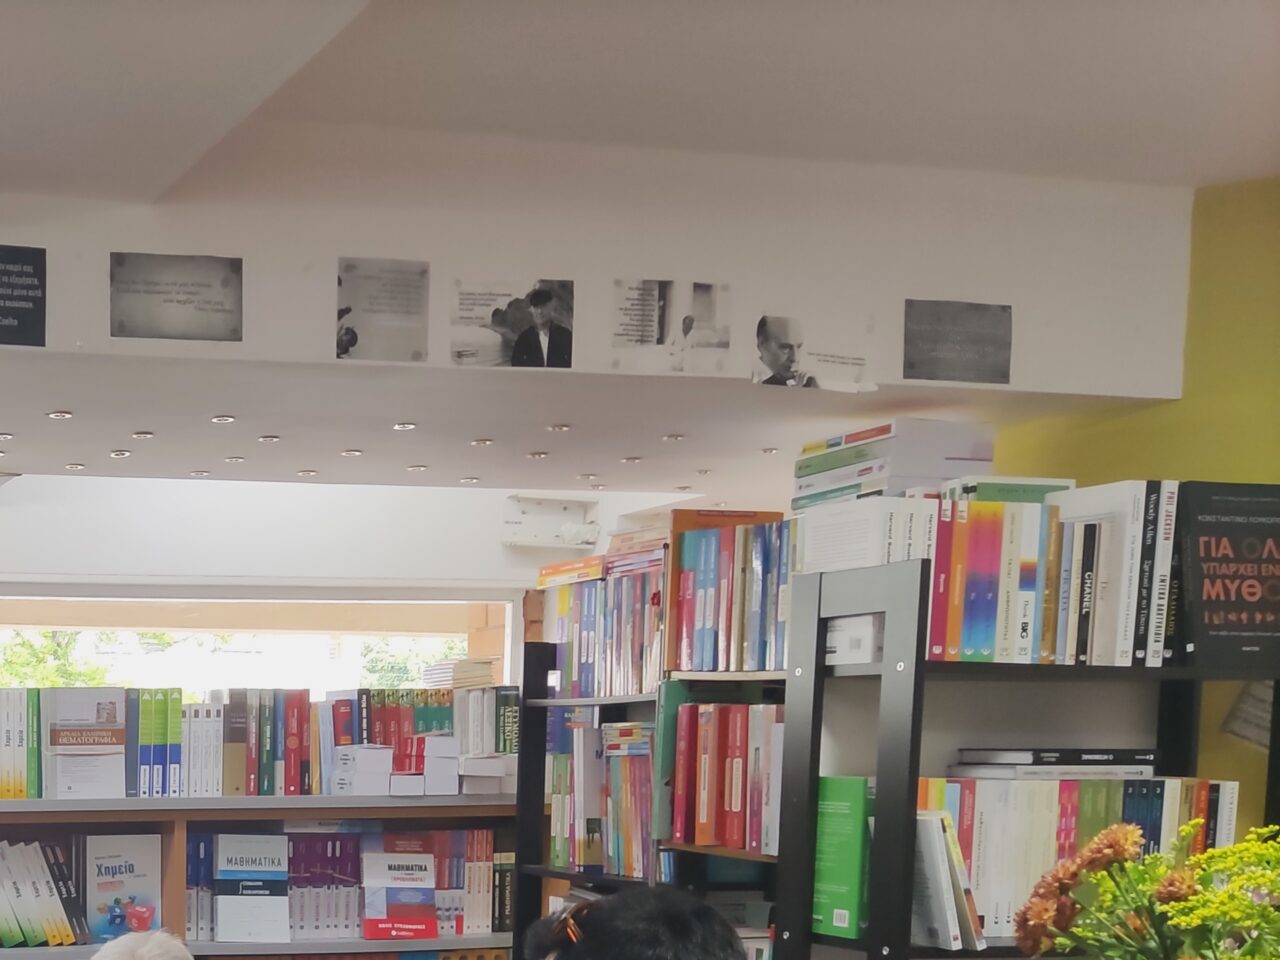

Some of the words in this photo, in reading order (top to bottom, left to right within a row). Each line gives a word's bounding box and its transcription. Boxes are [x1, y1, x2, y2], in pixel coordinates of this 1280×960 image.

[1146, 492, 1159, 521] Woody
[1145, 523, 1156, 545] Allen
[1163, 509, 1173, 542] JACKSON
[1199, 536, 1234, 558] ΓΙΑ
[1202, 563, 1258, 576] ΥΠΑΡΧΕΙ
[1082, 571, 1093, 615] CHANEL
[1021, 622, 1029, 639] BIG
[504, 706, 513, 739] ΛΕΞΙΚΟ
[96, 861, 135, 878] Χημεία
[226, 856, 283, 868] ΜΑΘΗΜΑΤΙΚΑ
[387, 864, 428, 872] ΜΑΘΗΜΑΤΙΚΑ
